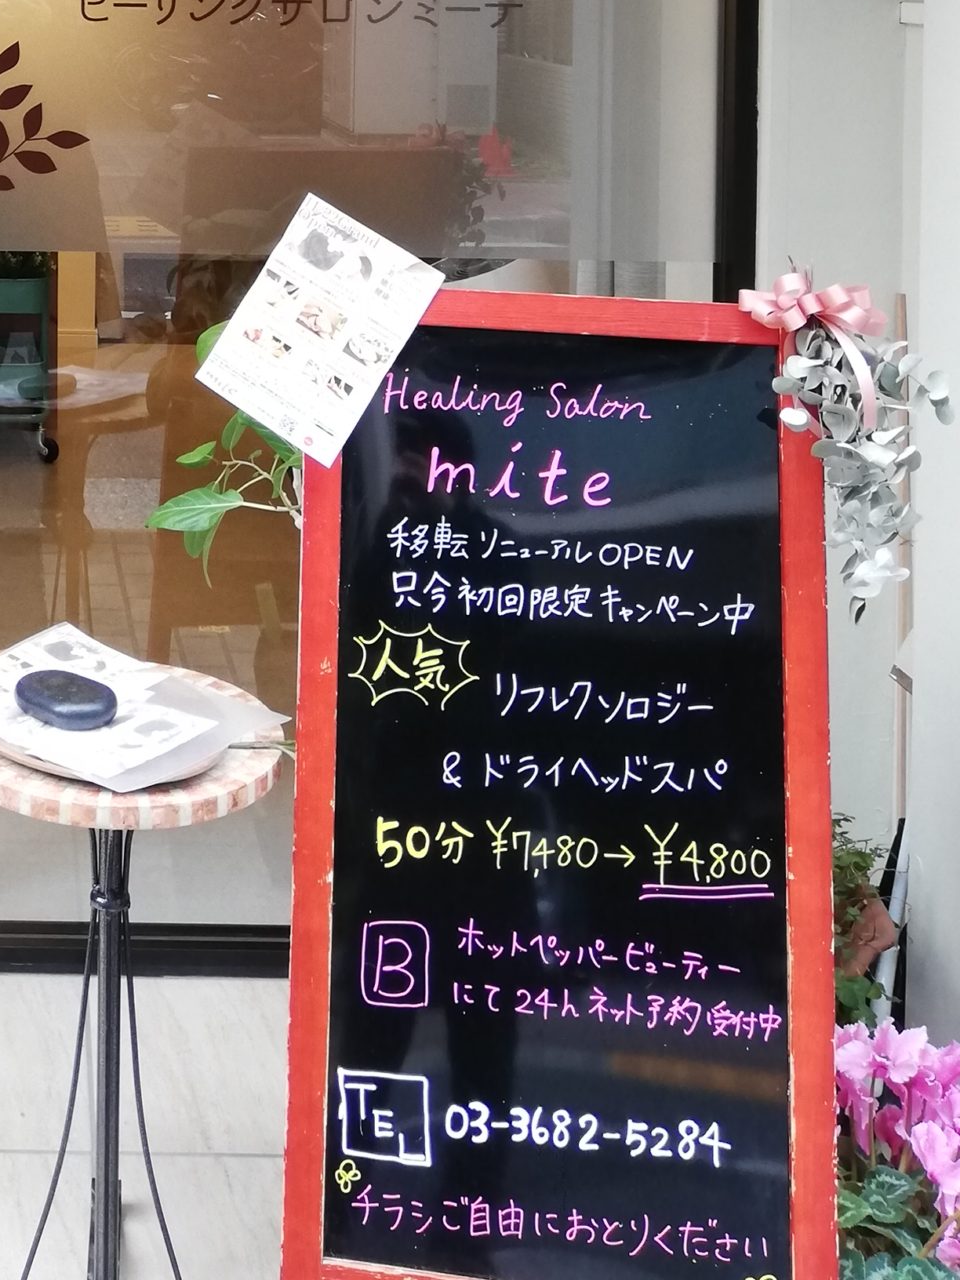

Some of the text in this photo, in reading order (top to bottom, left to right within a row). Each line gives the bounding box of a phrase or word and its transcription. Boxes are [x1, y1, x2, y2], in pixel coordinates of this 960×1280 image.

[383, 371, 652, 427] Healing Salon
[426, 441, 611, 507] mite
[371, 637, 450, 693] 人気
[495, 672, 715, 723] リフレクソロジー
[442, 750, 729, 794] & ドライヘッドスパ
[376, 816, 474, 868] 50分
[644, 822, 771, 885] ¥4,800
[373, 934, 416, 997] B
[457, 917, 741, 980] ホットペッパービューティー
[344, 1082, 426, 1162] TEL
[444, 1100, 732, 1169] 03-3682-5284
[350, 1182, 769, 1263] チラシご自由におとりください
